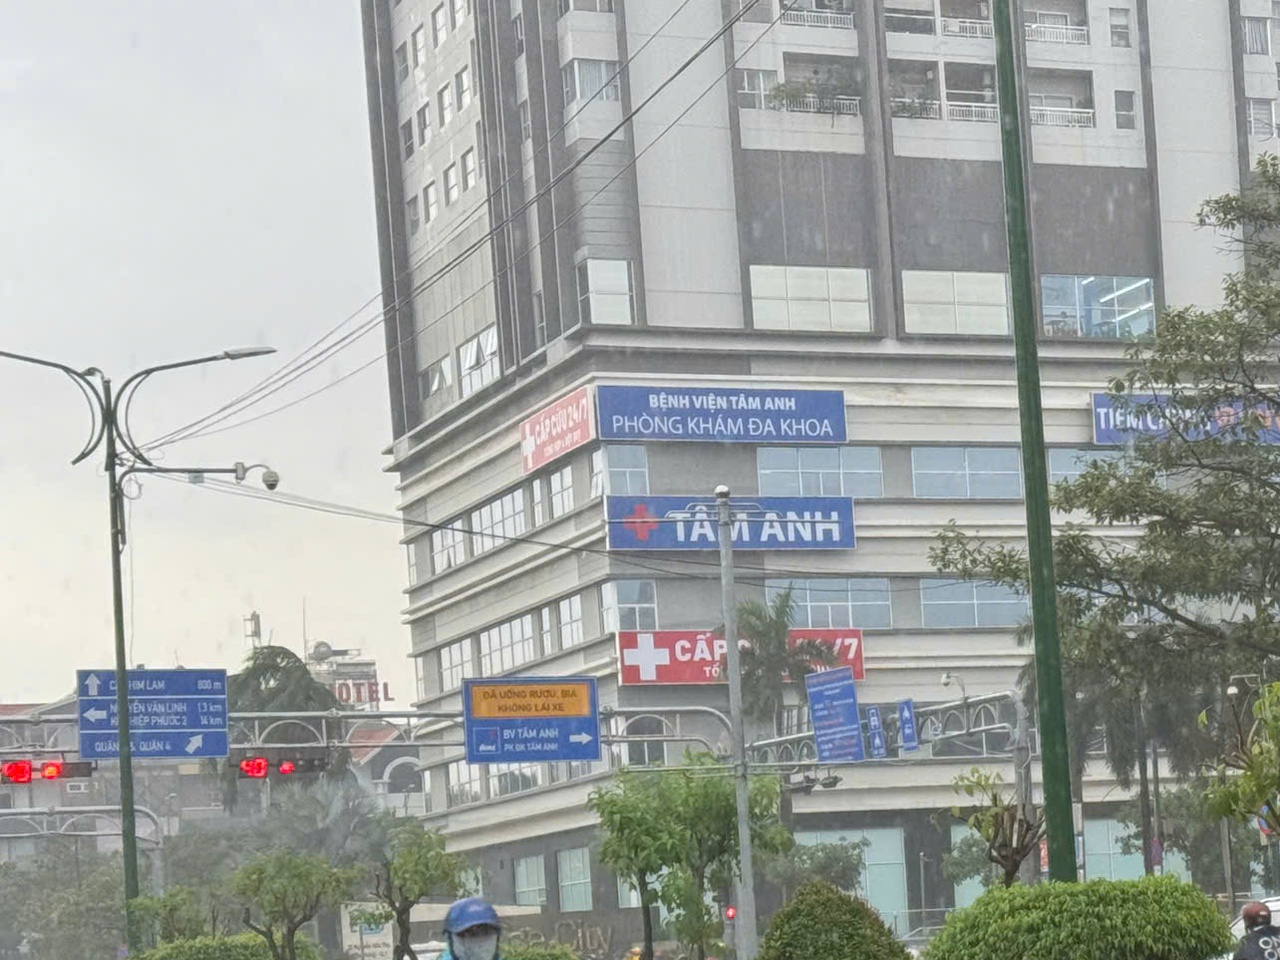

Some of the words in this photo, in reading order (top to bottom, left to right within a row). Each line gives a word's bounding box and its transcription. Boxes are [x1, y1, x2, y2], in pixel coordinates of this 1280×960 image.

[649, 392, 690, 412] BỆNH
[691, 393, 727, 413] VIỆN
[729, 393, 761, 410] TÂM
[764, 396, 796, 411] ANH
[612, 411, 683, 435] PHÒNG
[688, 414, 744, 436] KHÁM
[748, 417, 776, 436] ĐA
[780, 418, 833, 437] KHOA
[668, 504, 750, 542] TÂM
[760, 511, 840, 542] ANH
[675, 633, 728, 662] CẤP
[146, 680, 165, 690] LAM
[213, 681, 222, 690] m
[332, 681, 395, 703] OTEL
[561, 689, 577, 699] BIA
[166, 702, 187, 712] LINH
[209, 702, 222, 712] km
[552, 703, 565, 712] XE
[181, 716, 188, 726] 2
[209, 715, 223, 725] km
[503, 729, 516, 740] BV
[517, 726, 538, 739] TÂM
[539, 728, 559, 739] ANH
[543, 743, 559, 751] ANH
